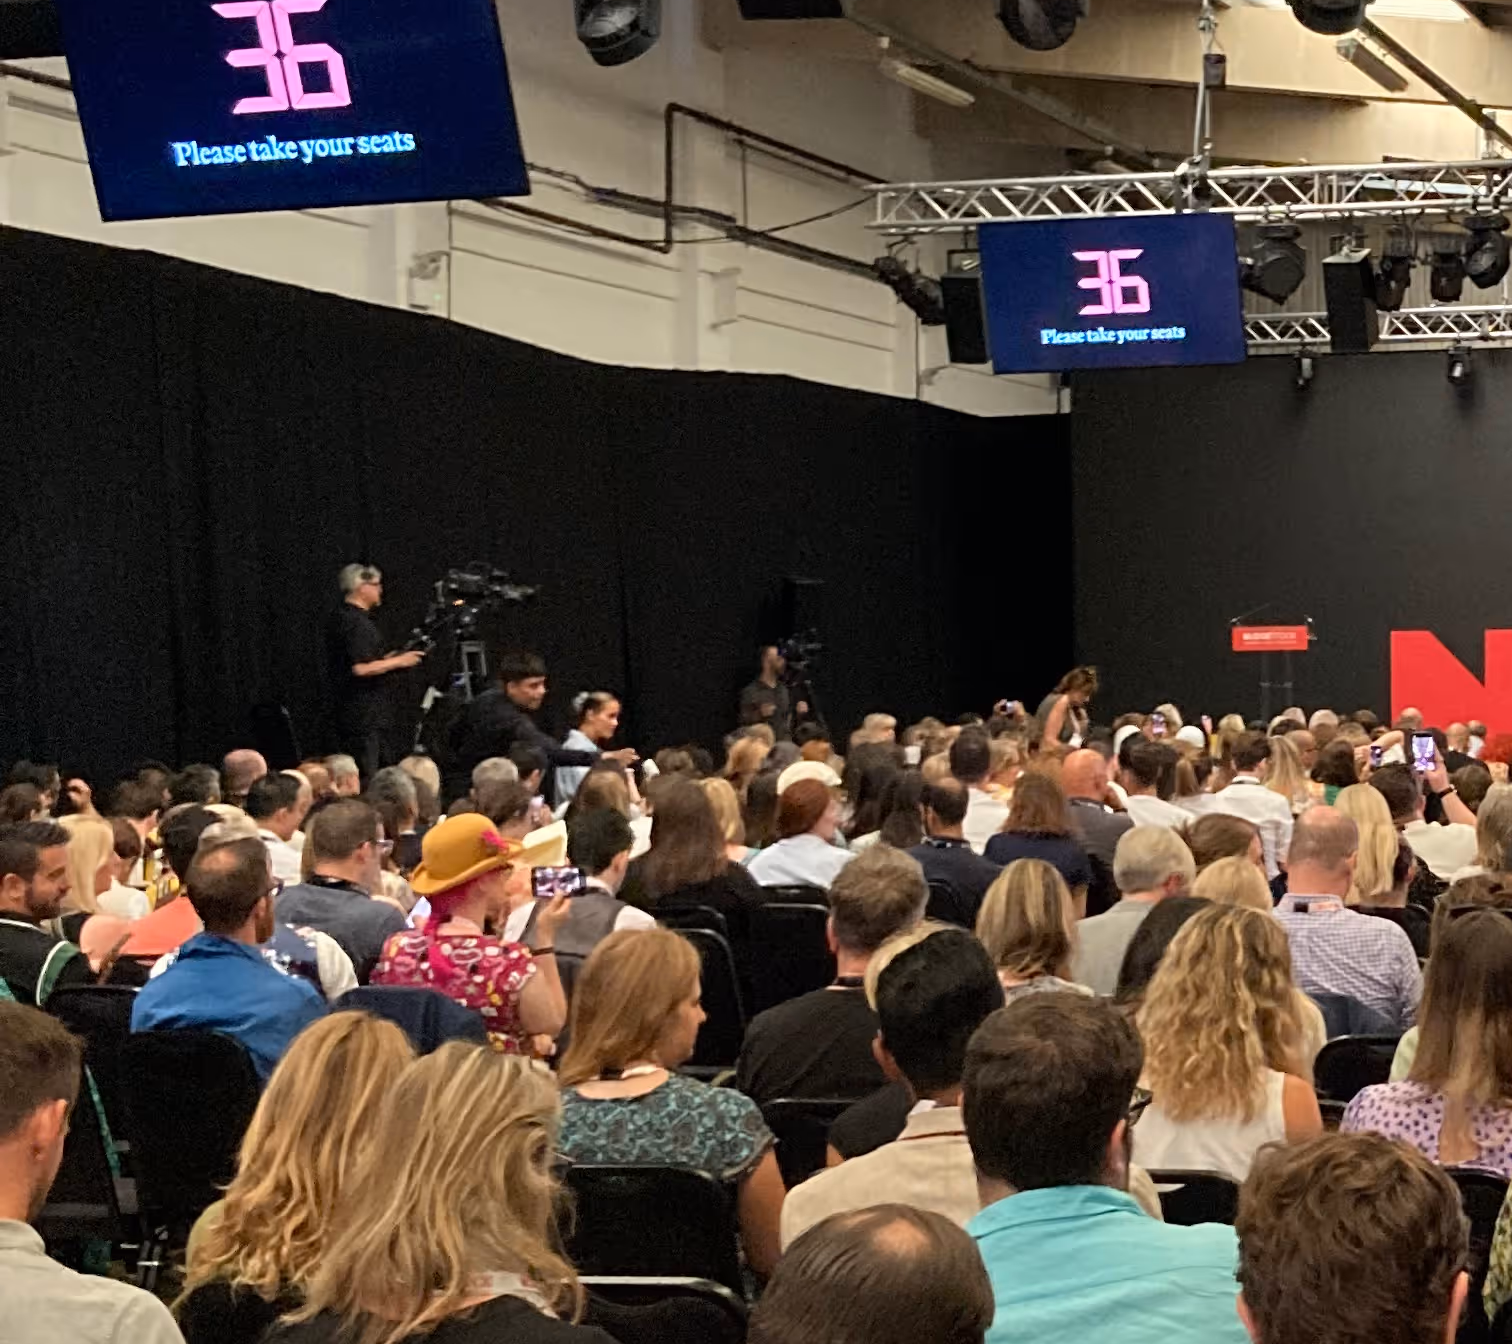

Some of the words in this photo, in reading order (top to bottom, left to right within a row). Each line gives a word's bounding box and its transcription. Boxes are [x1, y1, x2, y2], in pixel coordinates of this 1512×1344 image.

[172, 140, 247, 166] Please
[247, 135, 299, 161] take
[299, 137, 354, 164] your
[356, 131, 416, 155] seats
[1073, 248, 1150, 316] 36
[1040, 328, 1085, 345] Please
[1086, 326, 1116, 343] take
[1116, 328, 1150, 345] your
[1151, 326, 1187, 340] seats
